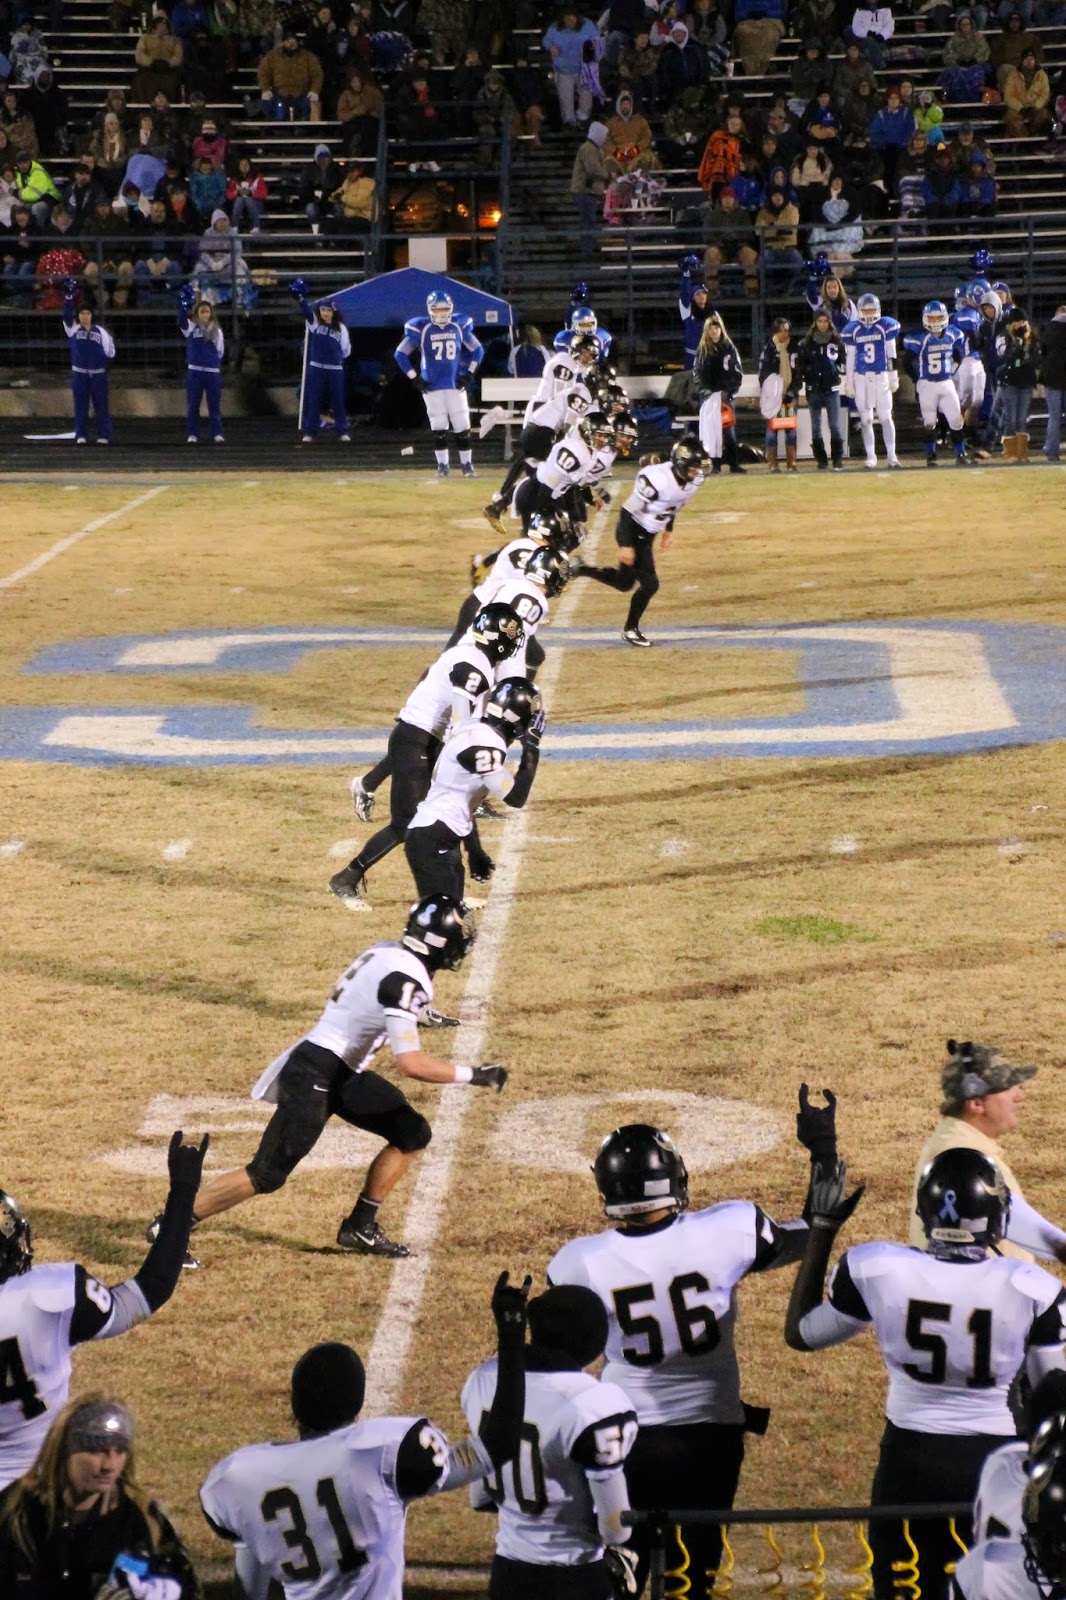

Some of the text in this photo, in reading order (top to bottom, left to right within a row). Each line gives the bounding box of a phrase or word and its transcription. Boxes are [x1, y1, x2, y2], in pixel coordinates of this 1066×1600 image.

[431, 340, 457, 360] 78
[864, 343, 875, 363] 3
[559, 367, 570, 380] 11
[571, 396, 588, 413] 33
[558, 451, 576, 470] 10
[516, 598, 541, 622] 80
[465, 672, 482, 693] 2
[475, 749, 502, 772] 21
[610, 1270, 722, 1367] 56
[901, 1297, 997, 1389] 51
[594, 1420, 639, 1465] 50
[260, 1476, 370, 1582] 31
